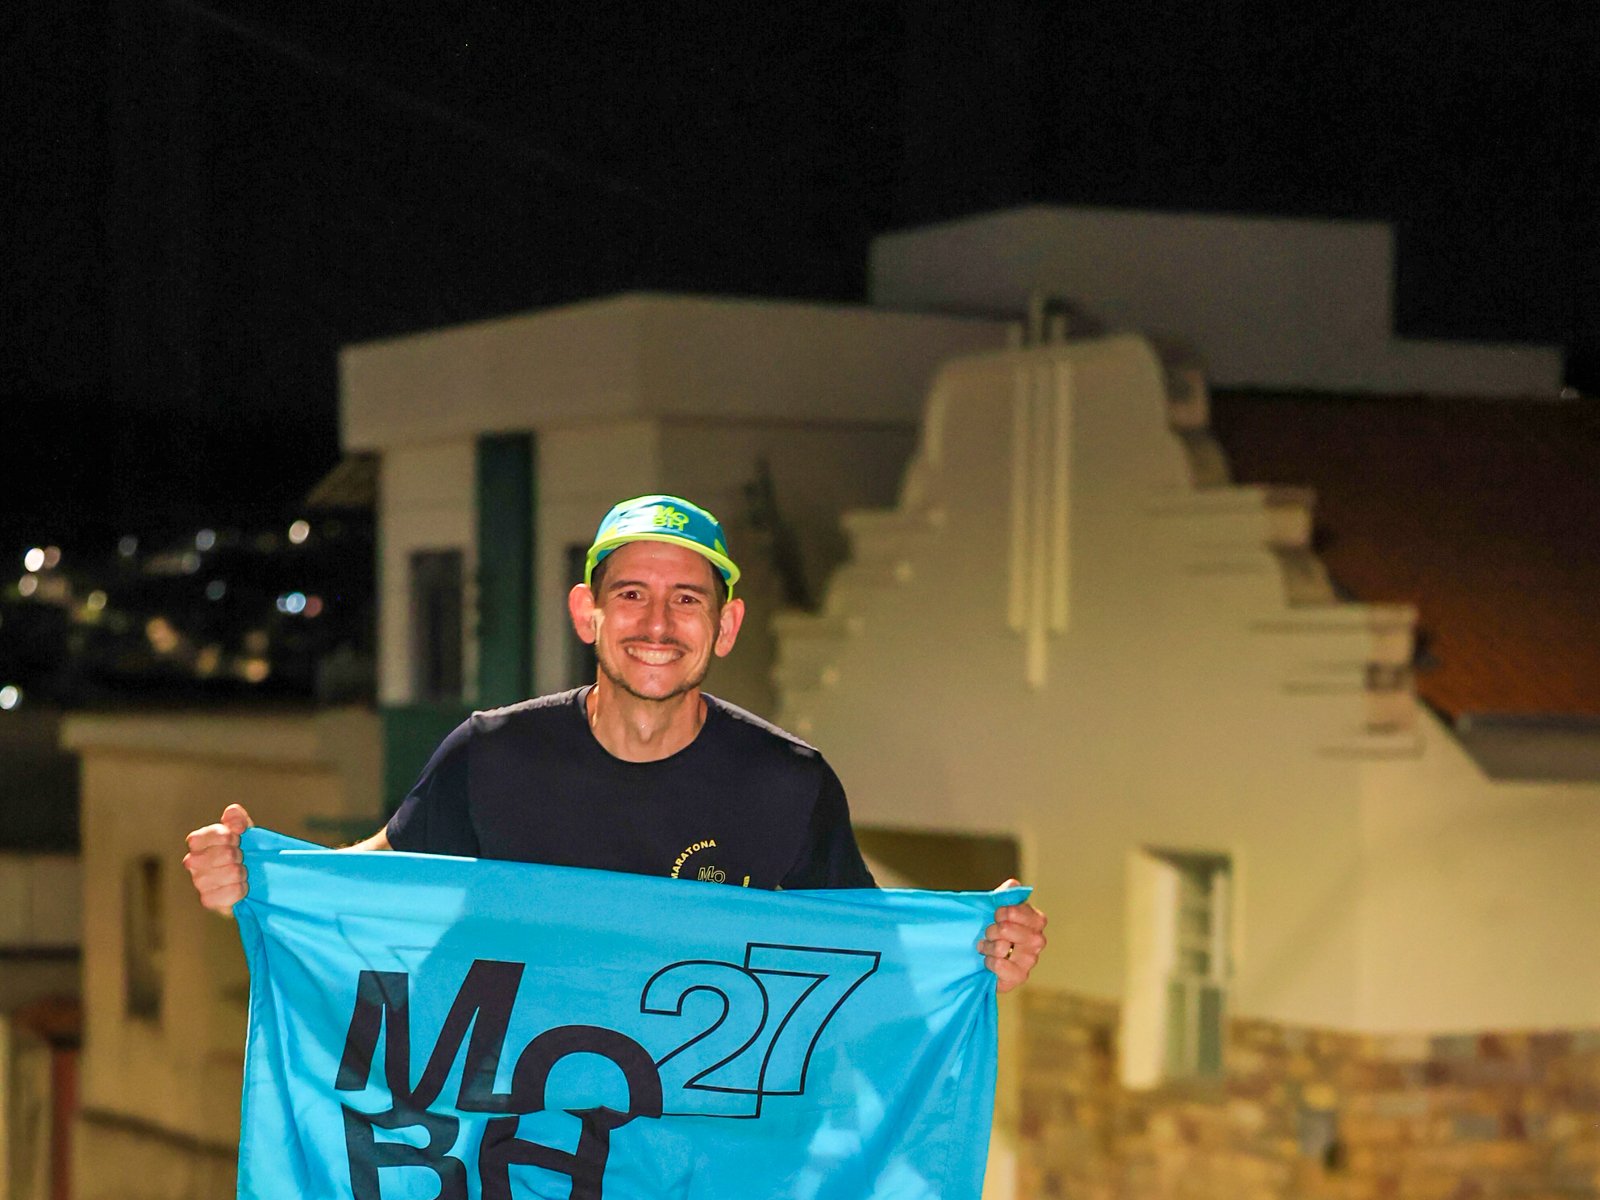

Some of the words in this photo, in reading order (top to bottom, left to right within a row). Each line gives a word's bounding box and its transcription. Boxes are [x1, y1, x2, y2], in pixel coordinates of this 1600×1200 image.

[671, 839, 716, 878] MARATONA
[335, 959, 663, 1130] MO
[640, 942, 881, 1119] 27
